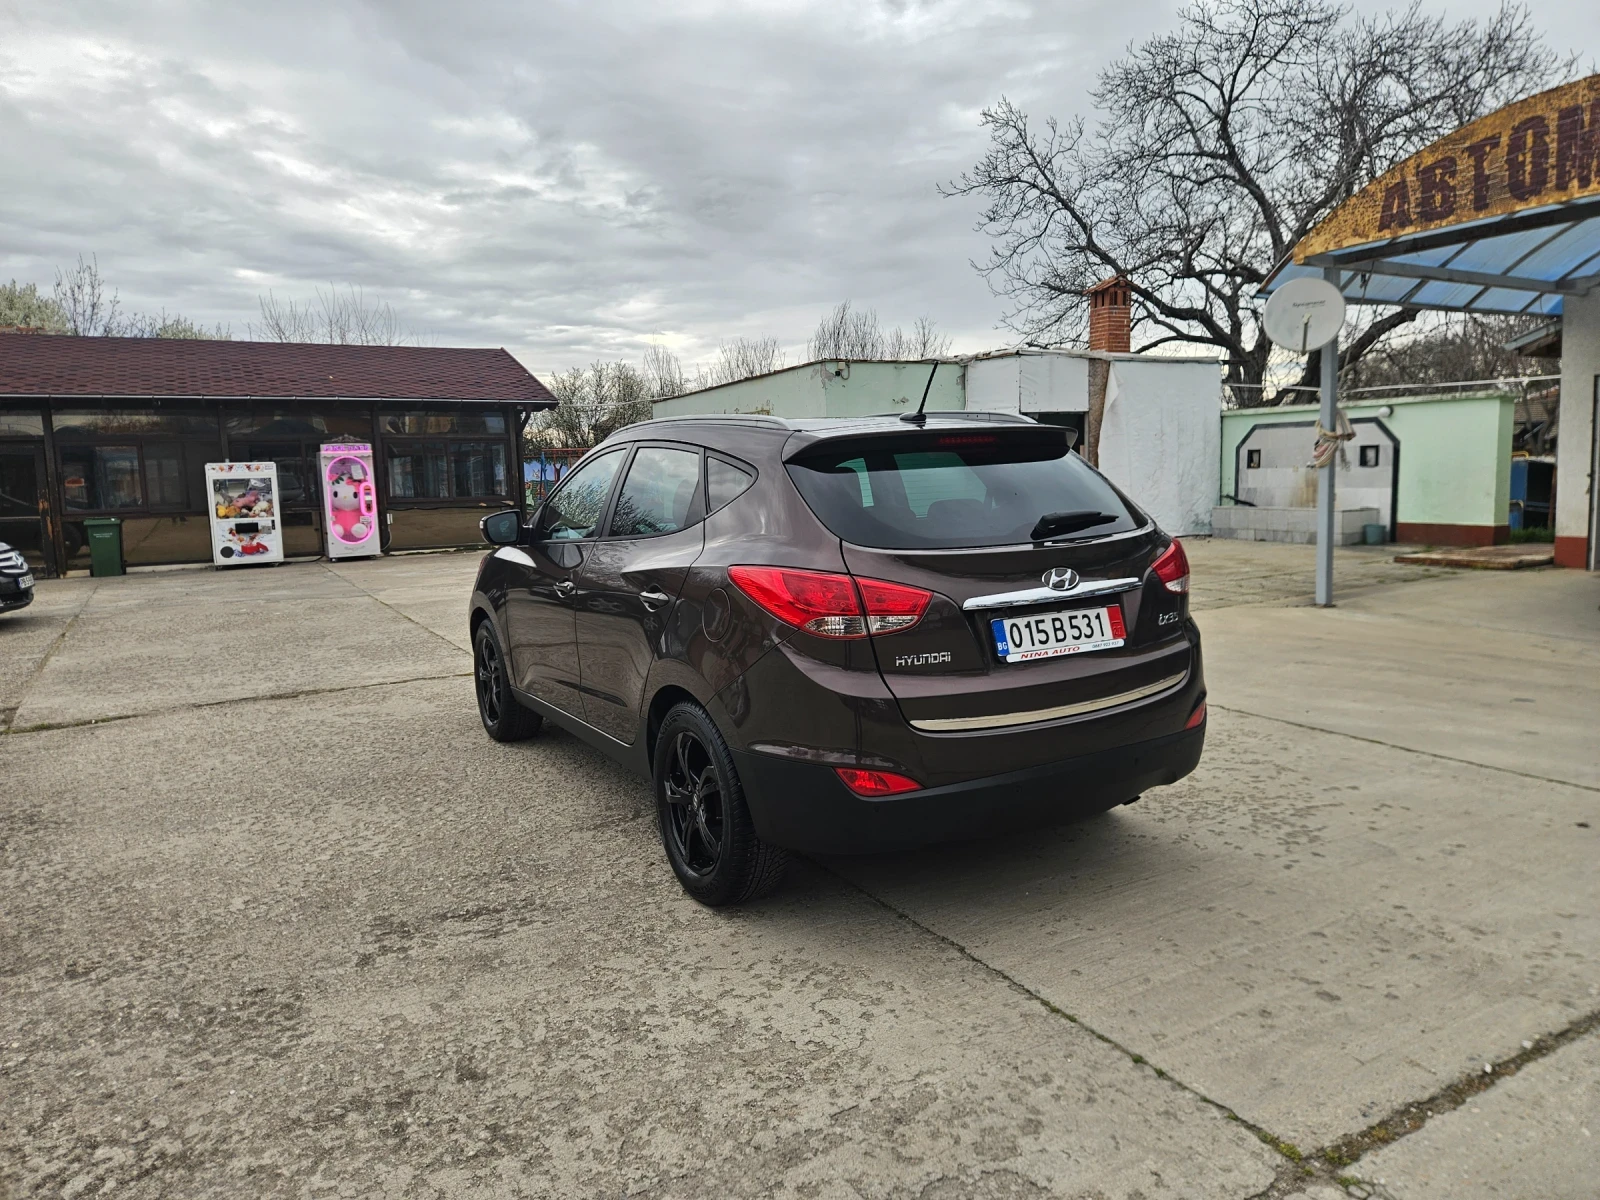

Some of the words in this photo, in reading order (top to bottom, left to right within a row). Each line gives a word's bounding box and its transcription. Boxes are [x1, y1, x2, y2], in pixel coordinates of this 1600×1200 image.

[997, 642, 1008, 651] BG
[1020, 651, 1049, 660] NINA
[1052, 646, 1080, 655] AUTO
[895, 651, 951, 667] HYUNDAI
